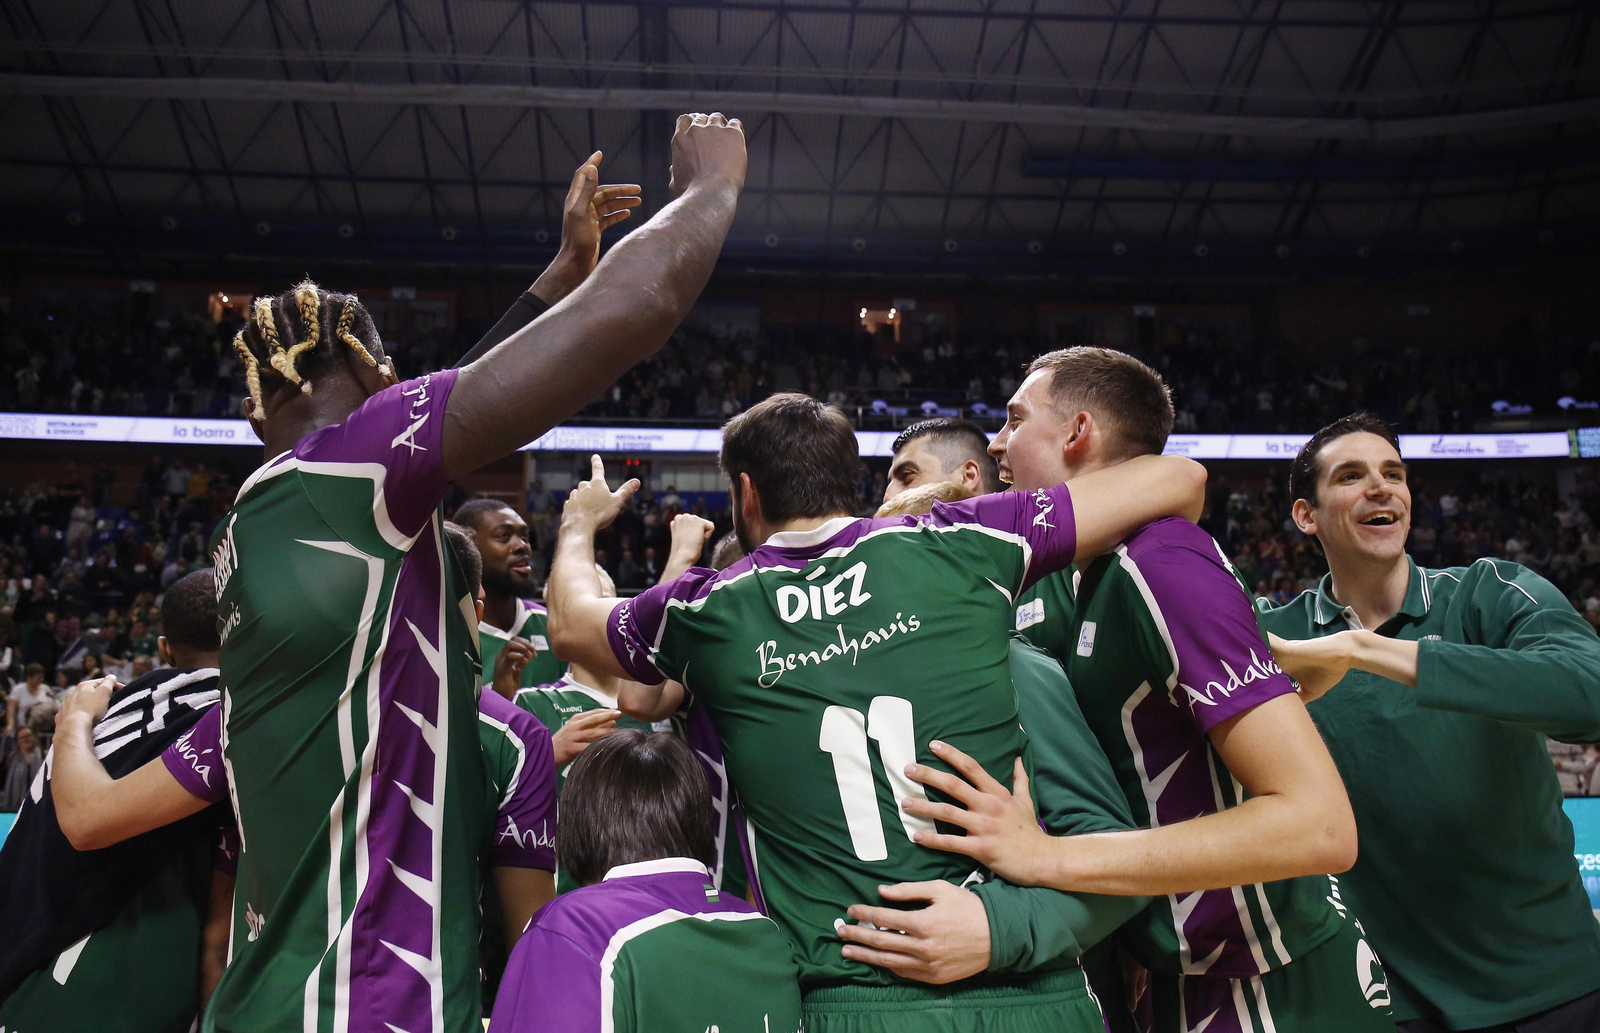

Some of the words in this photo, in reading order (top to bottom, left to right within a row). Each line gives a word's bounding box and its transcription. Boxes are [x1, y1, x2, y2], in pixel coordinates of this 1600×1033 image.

[173, 425, 187, 438] la
[193, 426, 235, 439] barra
[776, 561, 872, 623] DÍEZ
[819, 695, 938, 862] 11
